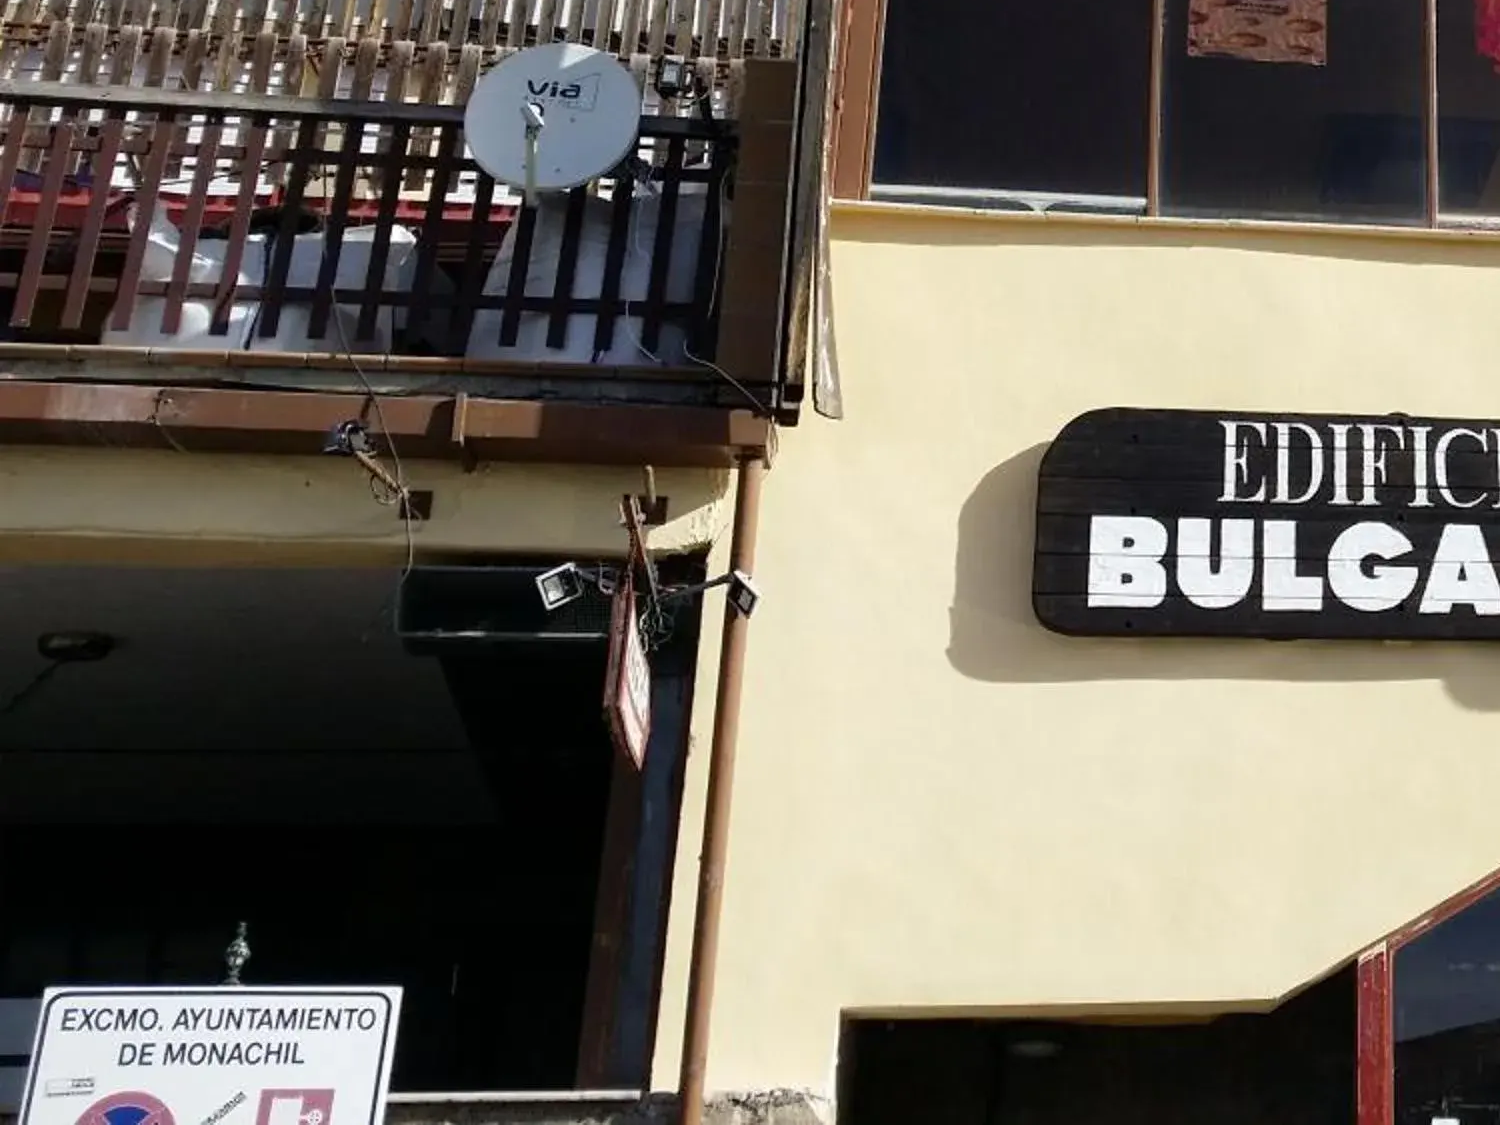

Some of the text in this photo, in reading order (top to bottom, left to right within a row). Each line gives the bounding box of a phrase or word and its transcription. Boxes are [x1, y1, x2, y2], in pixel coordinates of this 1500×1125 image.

[60, 1007, 377, 1031] EXCMO. AYUNTAMIENTO
[117, 1042, 305, 1067] DE MONACHIL
